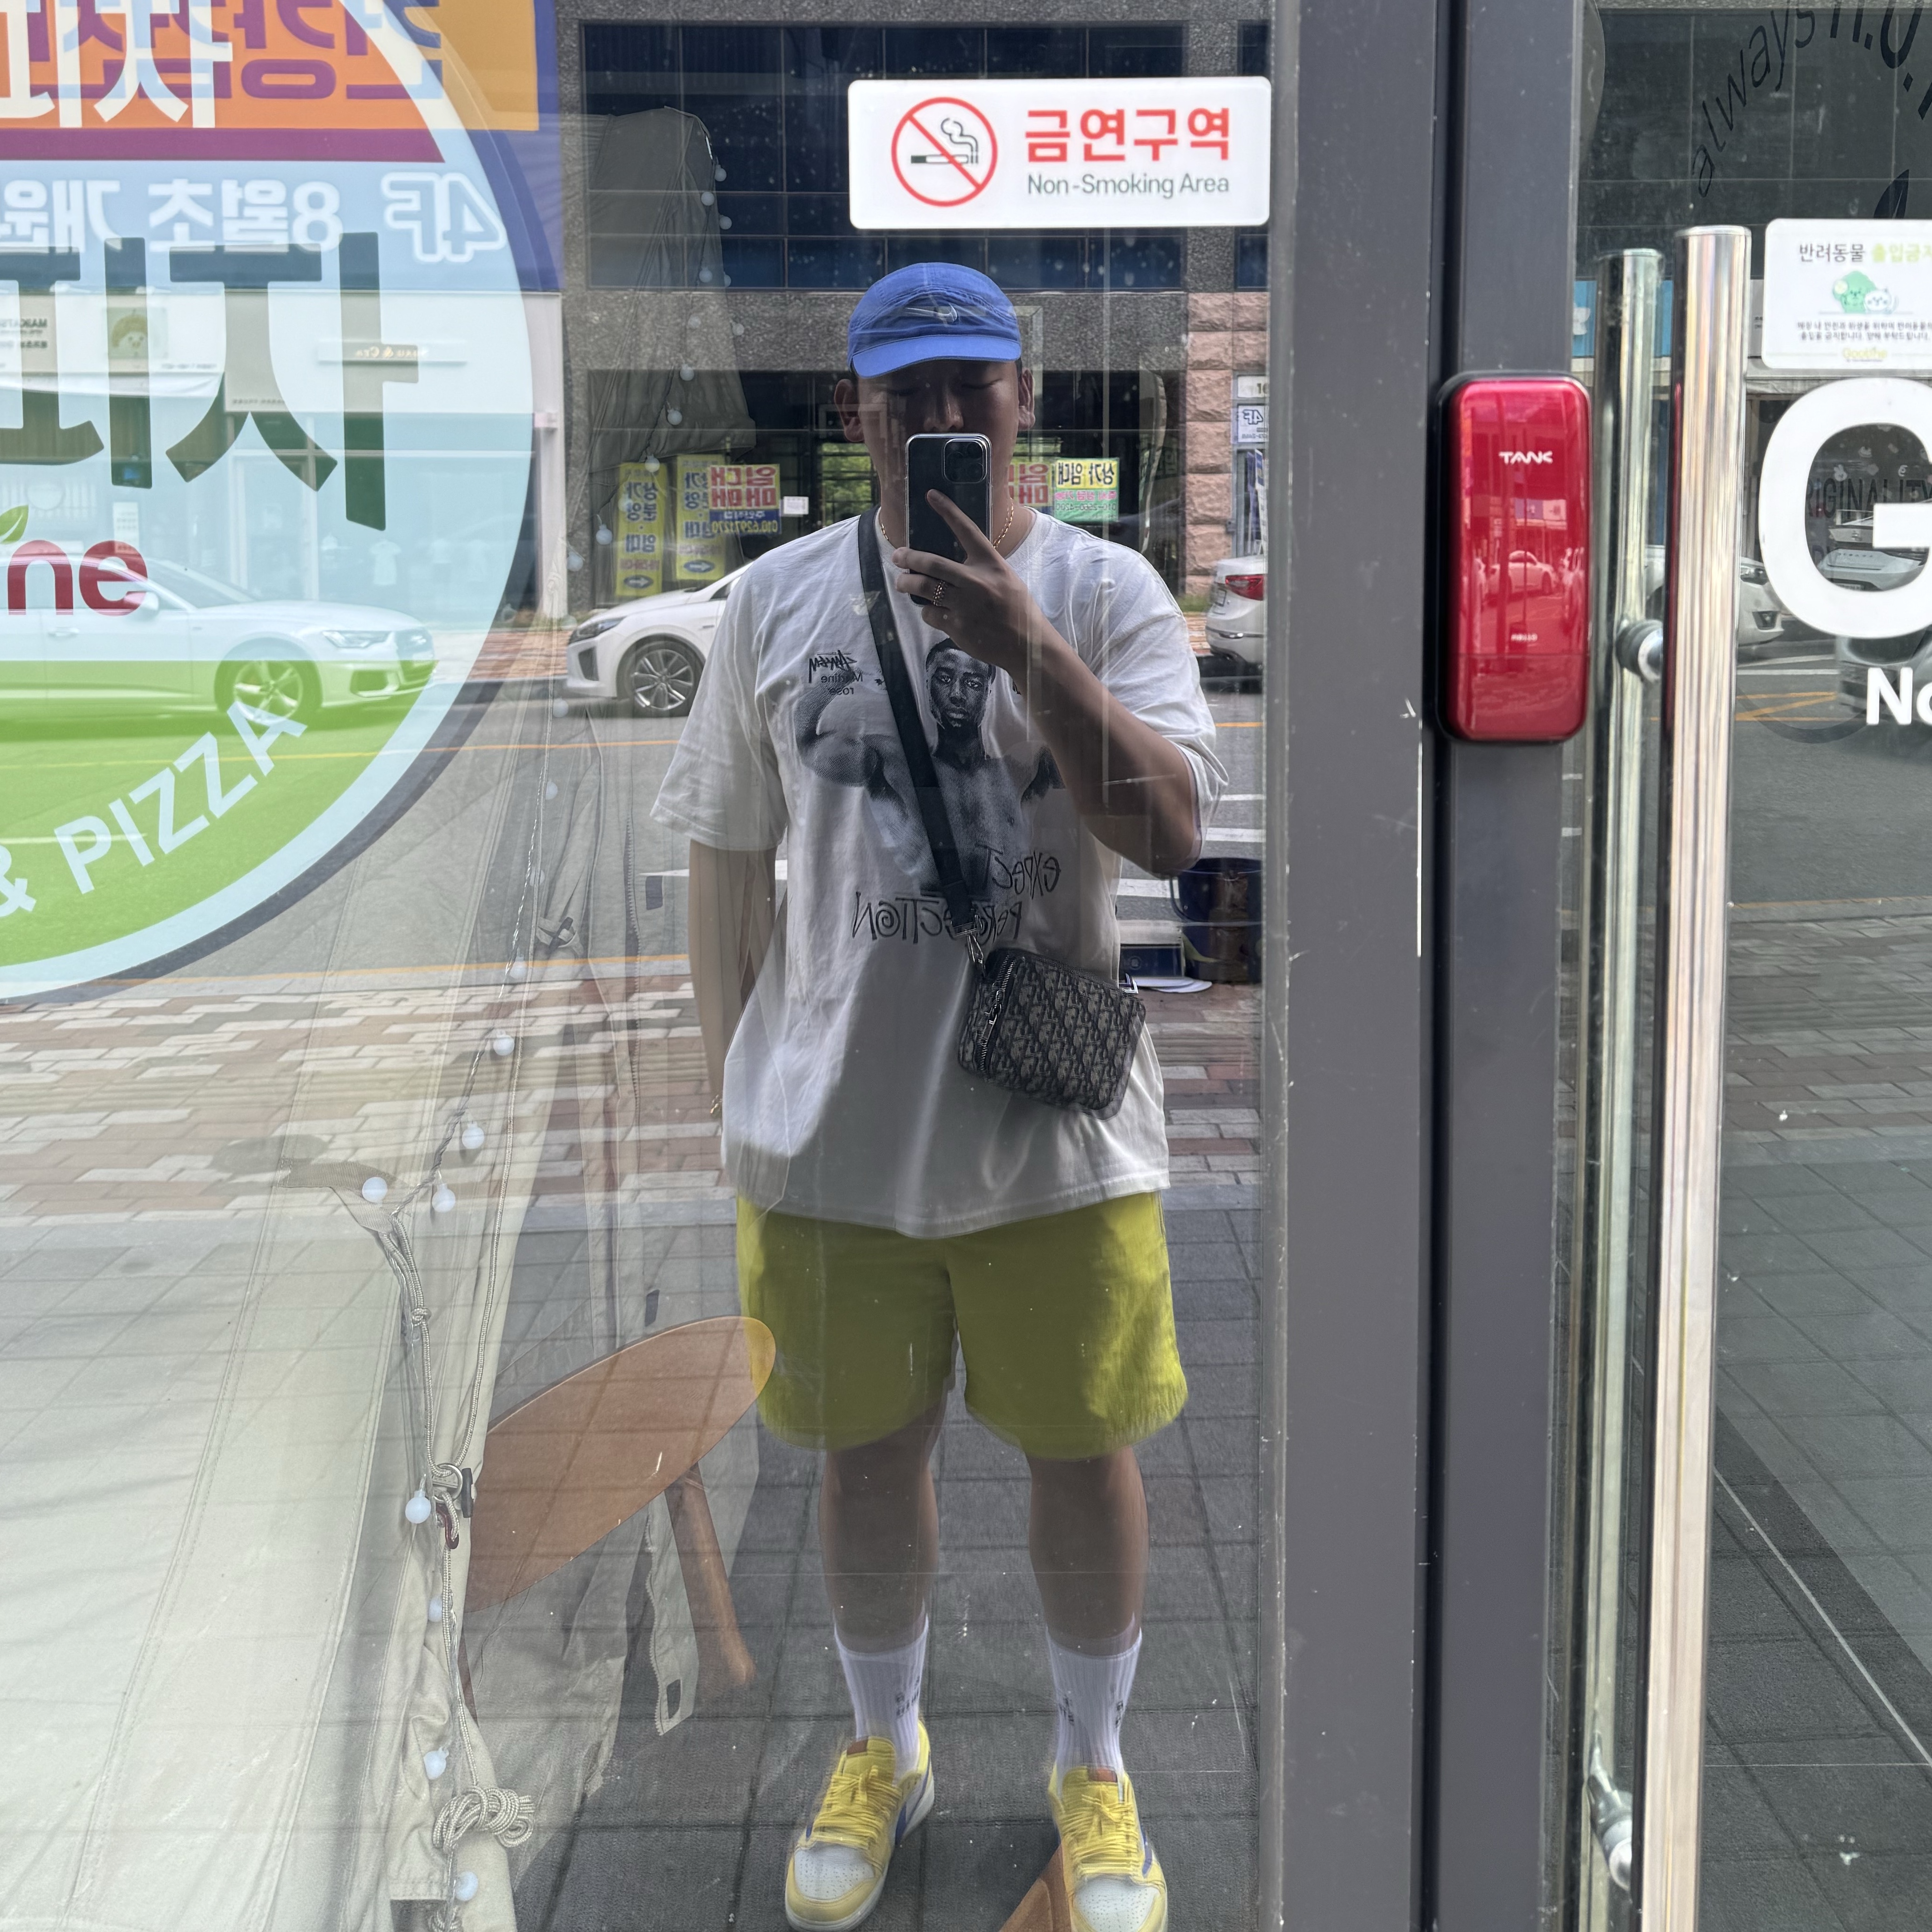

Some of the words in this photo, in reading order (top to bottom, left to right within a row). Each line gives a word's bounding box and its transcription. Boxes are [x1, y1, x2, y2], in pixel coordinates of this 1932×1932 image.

[1025, 107, 1229, 162] 금연구역
[1028, 174, 1174, 199] Non-Smoking
[1179, 174, 1229, 193] Area
[1800, 243, 1865, 262] 반려동물
[1499, 450, 1553, 464] TANK
[54, 701, 307, 893] PIZZA
